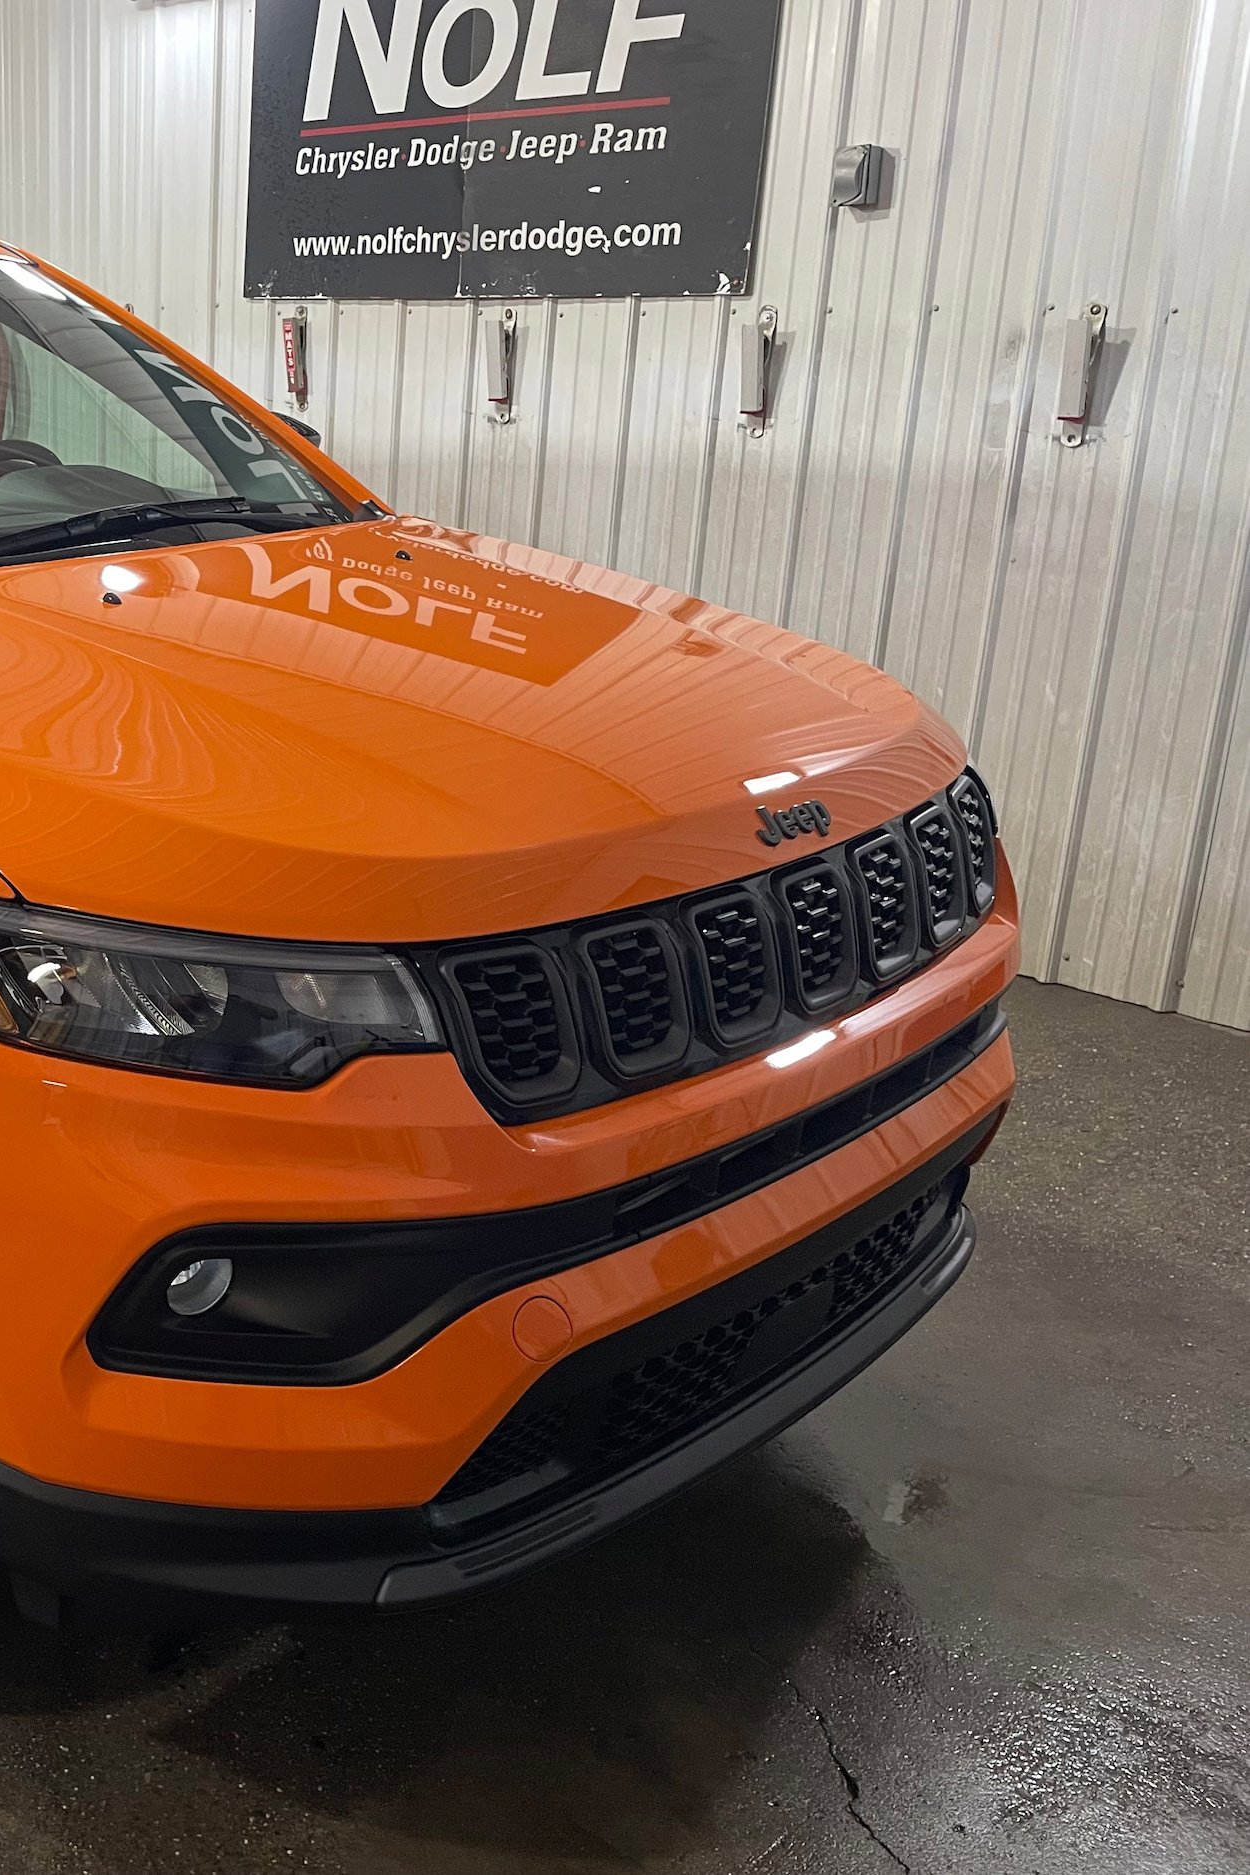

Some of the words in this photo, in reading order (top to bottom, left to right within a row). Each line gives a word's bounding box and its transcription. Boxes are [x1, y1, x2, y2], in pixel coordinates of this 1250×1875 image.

[302, 0, 686, 122] NOLF
[295, 145, 400, 179] Chrysler
[407, 134, 496, 170] Dodge
[506, 129, 578, 164] Jeep
[590, 122, 667, 155] Ram
[292, 220, 682, 260] www.nolfchryslerdodge.com
[756, 800, 832, 847] Jeep
